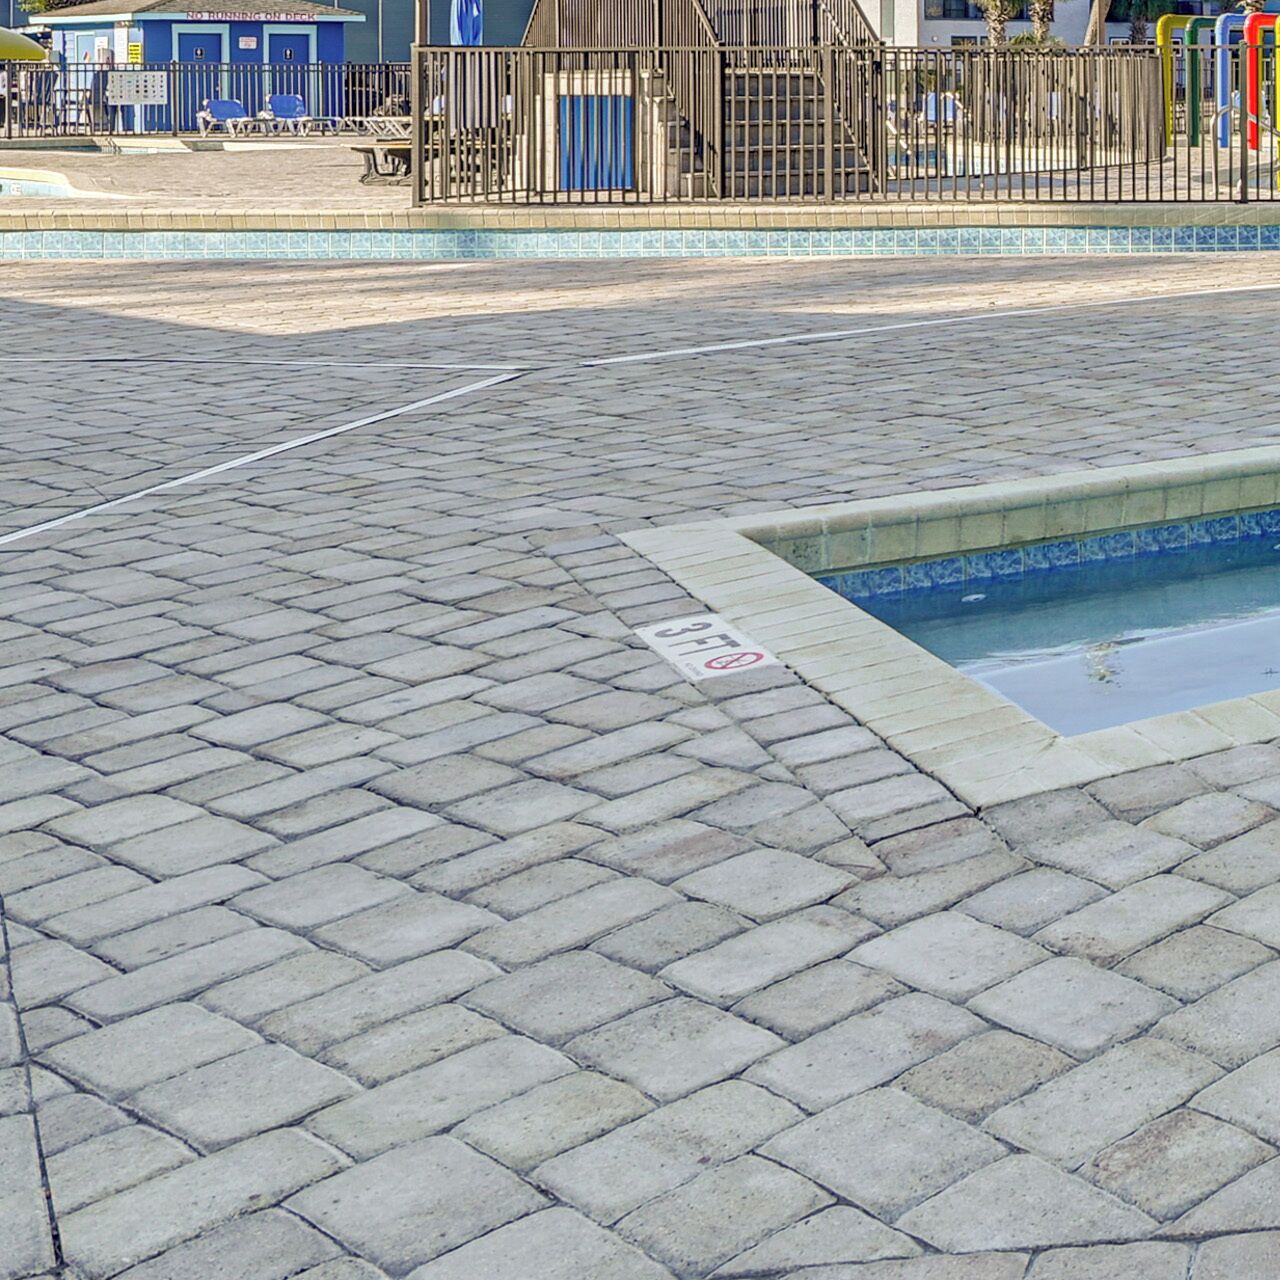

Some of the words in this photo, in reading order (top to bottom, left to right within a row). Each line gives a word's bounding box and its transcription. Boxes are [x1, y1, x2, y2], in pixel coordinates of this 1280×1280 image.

[187, 11, 203, 20] NO
[209, 11, 261, 21] RUNNING
[265, 12, 280, 21] ON
[286, 12, 316, 21] DECK
[654, 622, 713, 638] 3
[667, 633, 742, 657] FT
